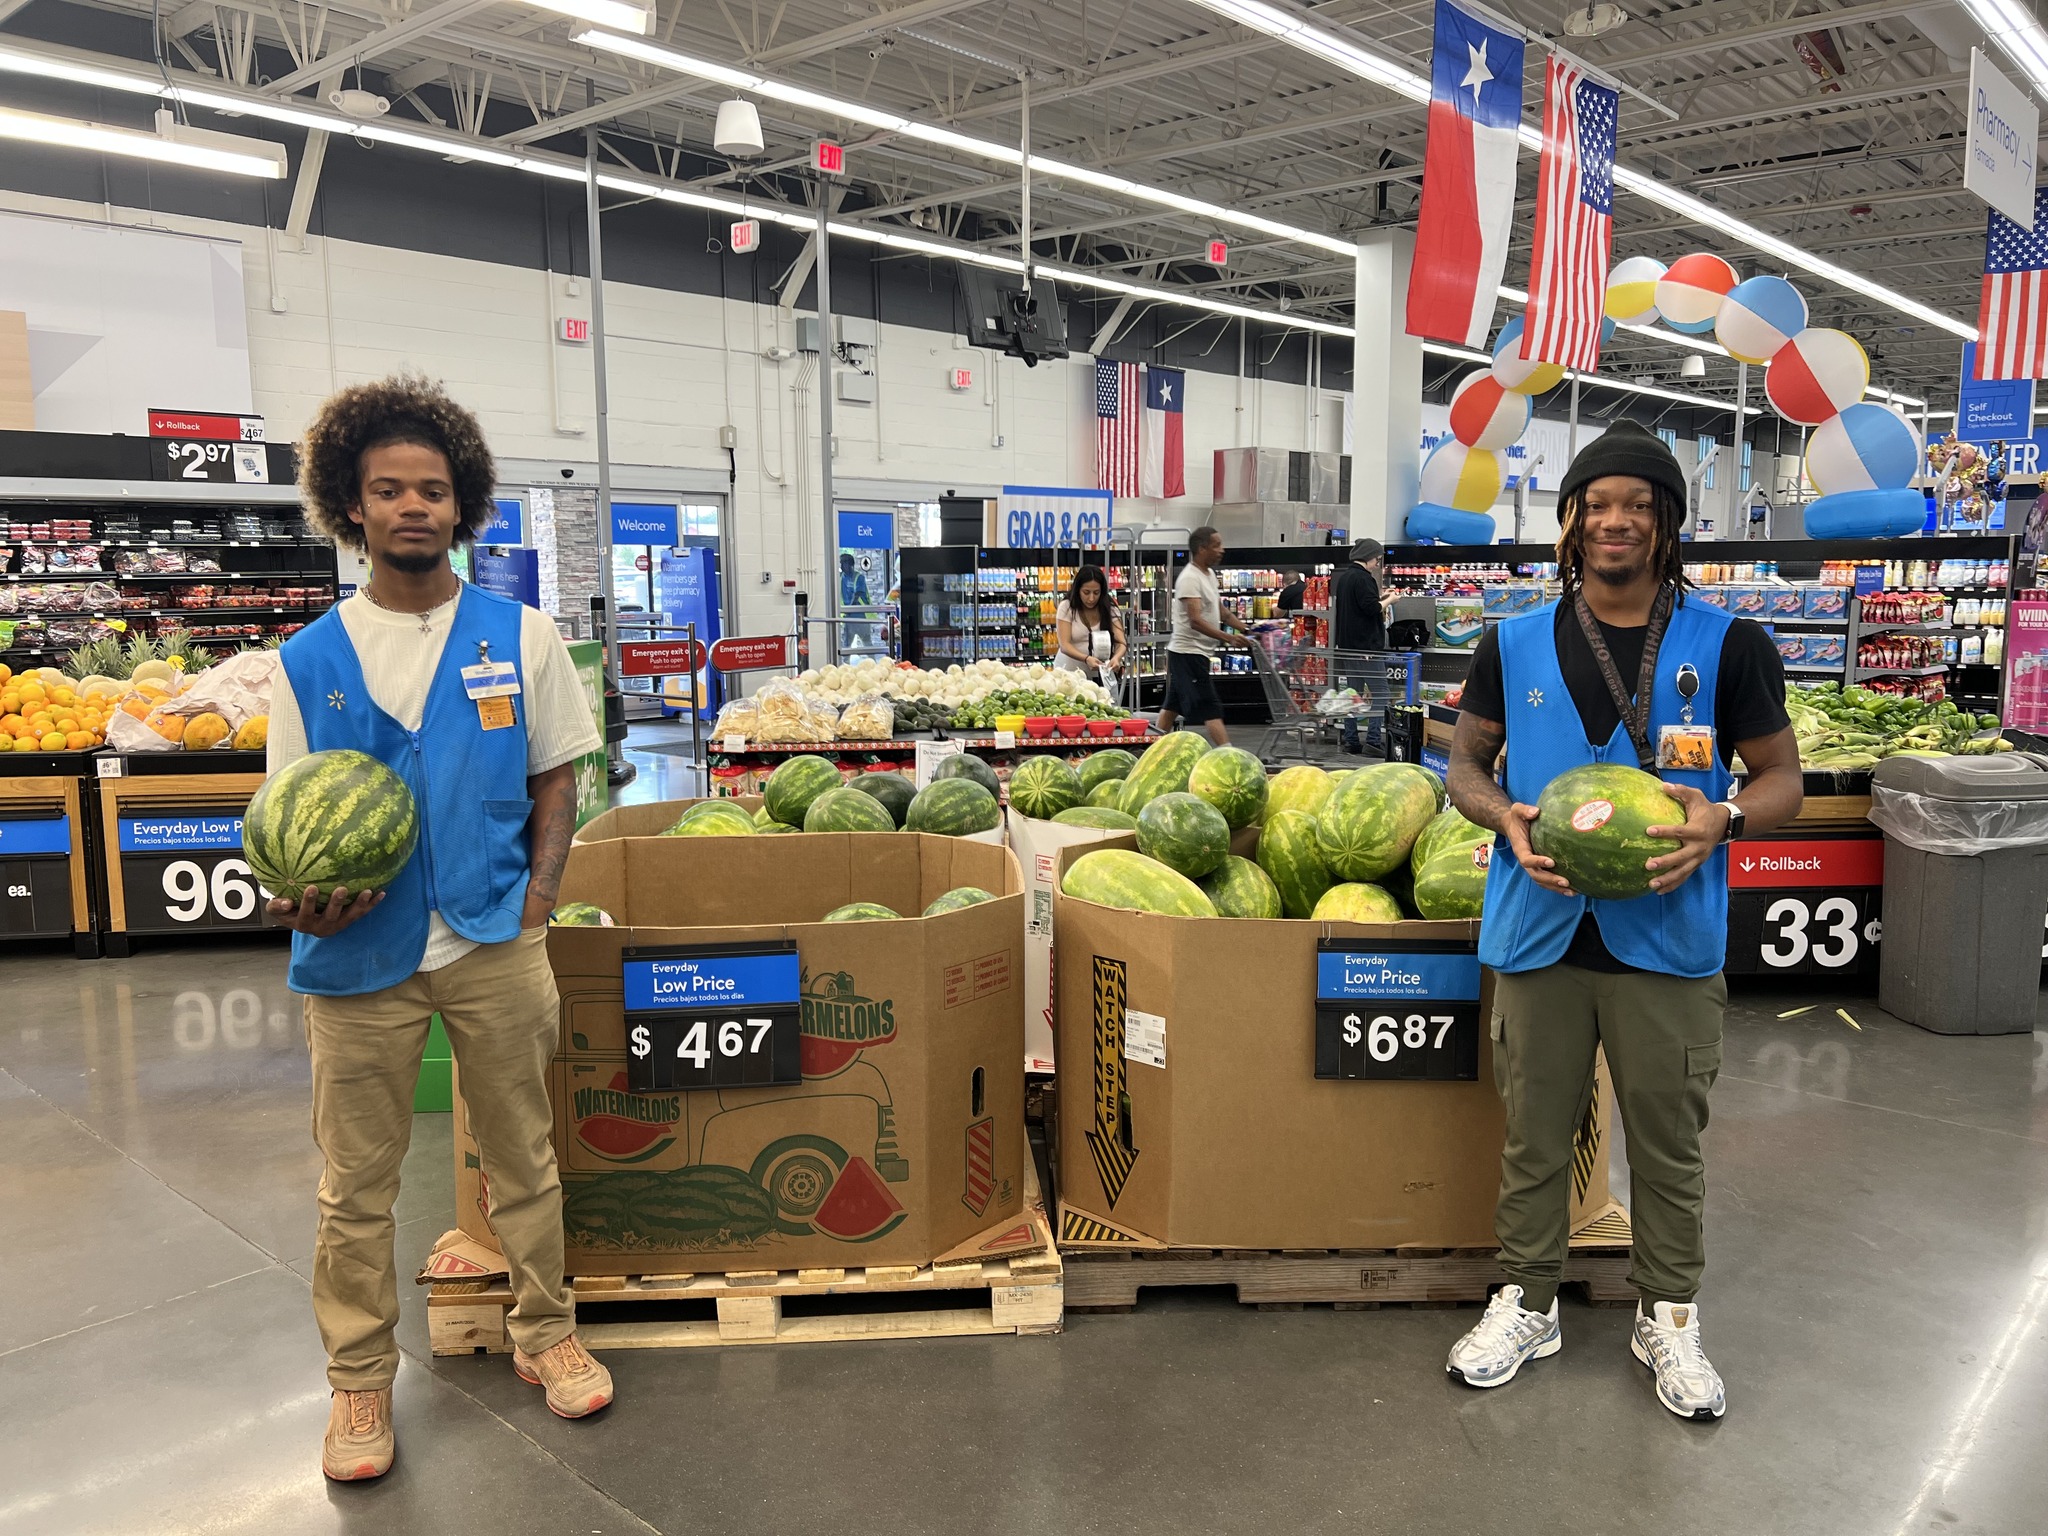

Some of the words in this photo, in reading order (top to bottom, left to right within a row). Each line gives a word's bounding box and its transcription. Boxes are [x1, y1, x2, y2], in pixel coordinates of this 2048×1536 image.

[1976, 87, 2020, 168] Pharmacy
[818, 143, 843, 171] EXIT
[1974, 140, 1995, 172] Farmacia
[734, 223, 751, 246] EXIT
[1210, 242, 1226, 263] EXIT
[566, 319, 588, 340] EXIT
[957, 369, 971, 385] EXIT
[1968, 403, 1987, 411] Self
[1967, 412, 2013, 422] Checkout
[166, 421, 200, 431] Rollback
[618, 518, 666, 532] Welcome
[857, 525, 873, 537] Exit
[1007, 510, 1054, 548] GRAB
[1061, 512, 1073, 548] &
[1077, 511, 1100, 548] GO
[477, 557, 504, 569] Pharmacy
[478, 569, 500, 582] delivery
[505, 572, 519, 583] here
[663, 574, 688, 584] members
[687, 575, 698, 586] get
[672, 586, 700, 597] pharmacy
[662, 598, 684, 609] delivery
[632, 649, 670, 658] Emergency
[670, 647, 683, 656] exit
[719, 644, 754, 654] Emergency
[754, 643, 766, 651] exit
[766, 642, 780, 651] only
[669, 657, 684, 665] open
[1386, 667, 1409, 681] 269
[1424, 753, 1440, 771] Everyday
[133, 821, 198, 837] Everyday
[202, 820, 230, 834] Low
[134, 837, 162, 845] Precios
[162, 836, 182, 845] bajos
[182, 836, 204, 844] todos
[205, 836, 216, 844] los
[1759, 856, 1821, 871] Rollback
[7, 884, 32, 897] ea.
[161, 858, 276, 922] 96
[652, 962, 699, 975] Everyday
[1345, 955, 1388, 968] Everyday
[1345, 969, 1377, 984] Low
[1381, 969, 1421, 985] Price
[653, 978, 687, 994] Low
[692, 975, 736, 992] Price
[1344, 986, 1367, 994] Precios
[1368, 987, 1385, 995] bajos
[653, 995, 679, 1003] Precios
[679, 994, 698, 1003] bajos
[699, 993, 719, 1001] todos
[1103, 966, 1116, 1049] WATCH
[1105, 1062, 1116, 1125] STEP
[573, 1086, 681, 1124] WATERMELONS
